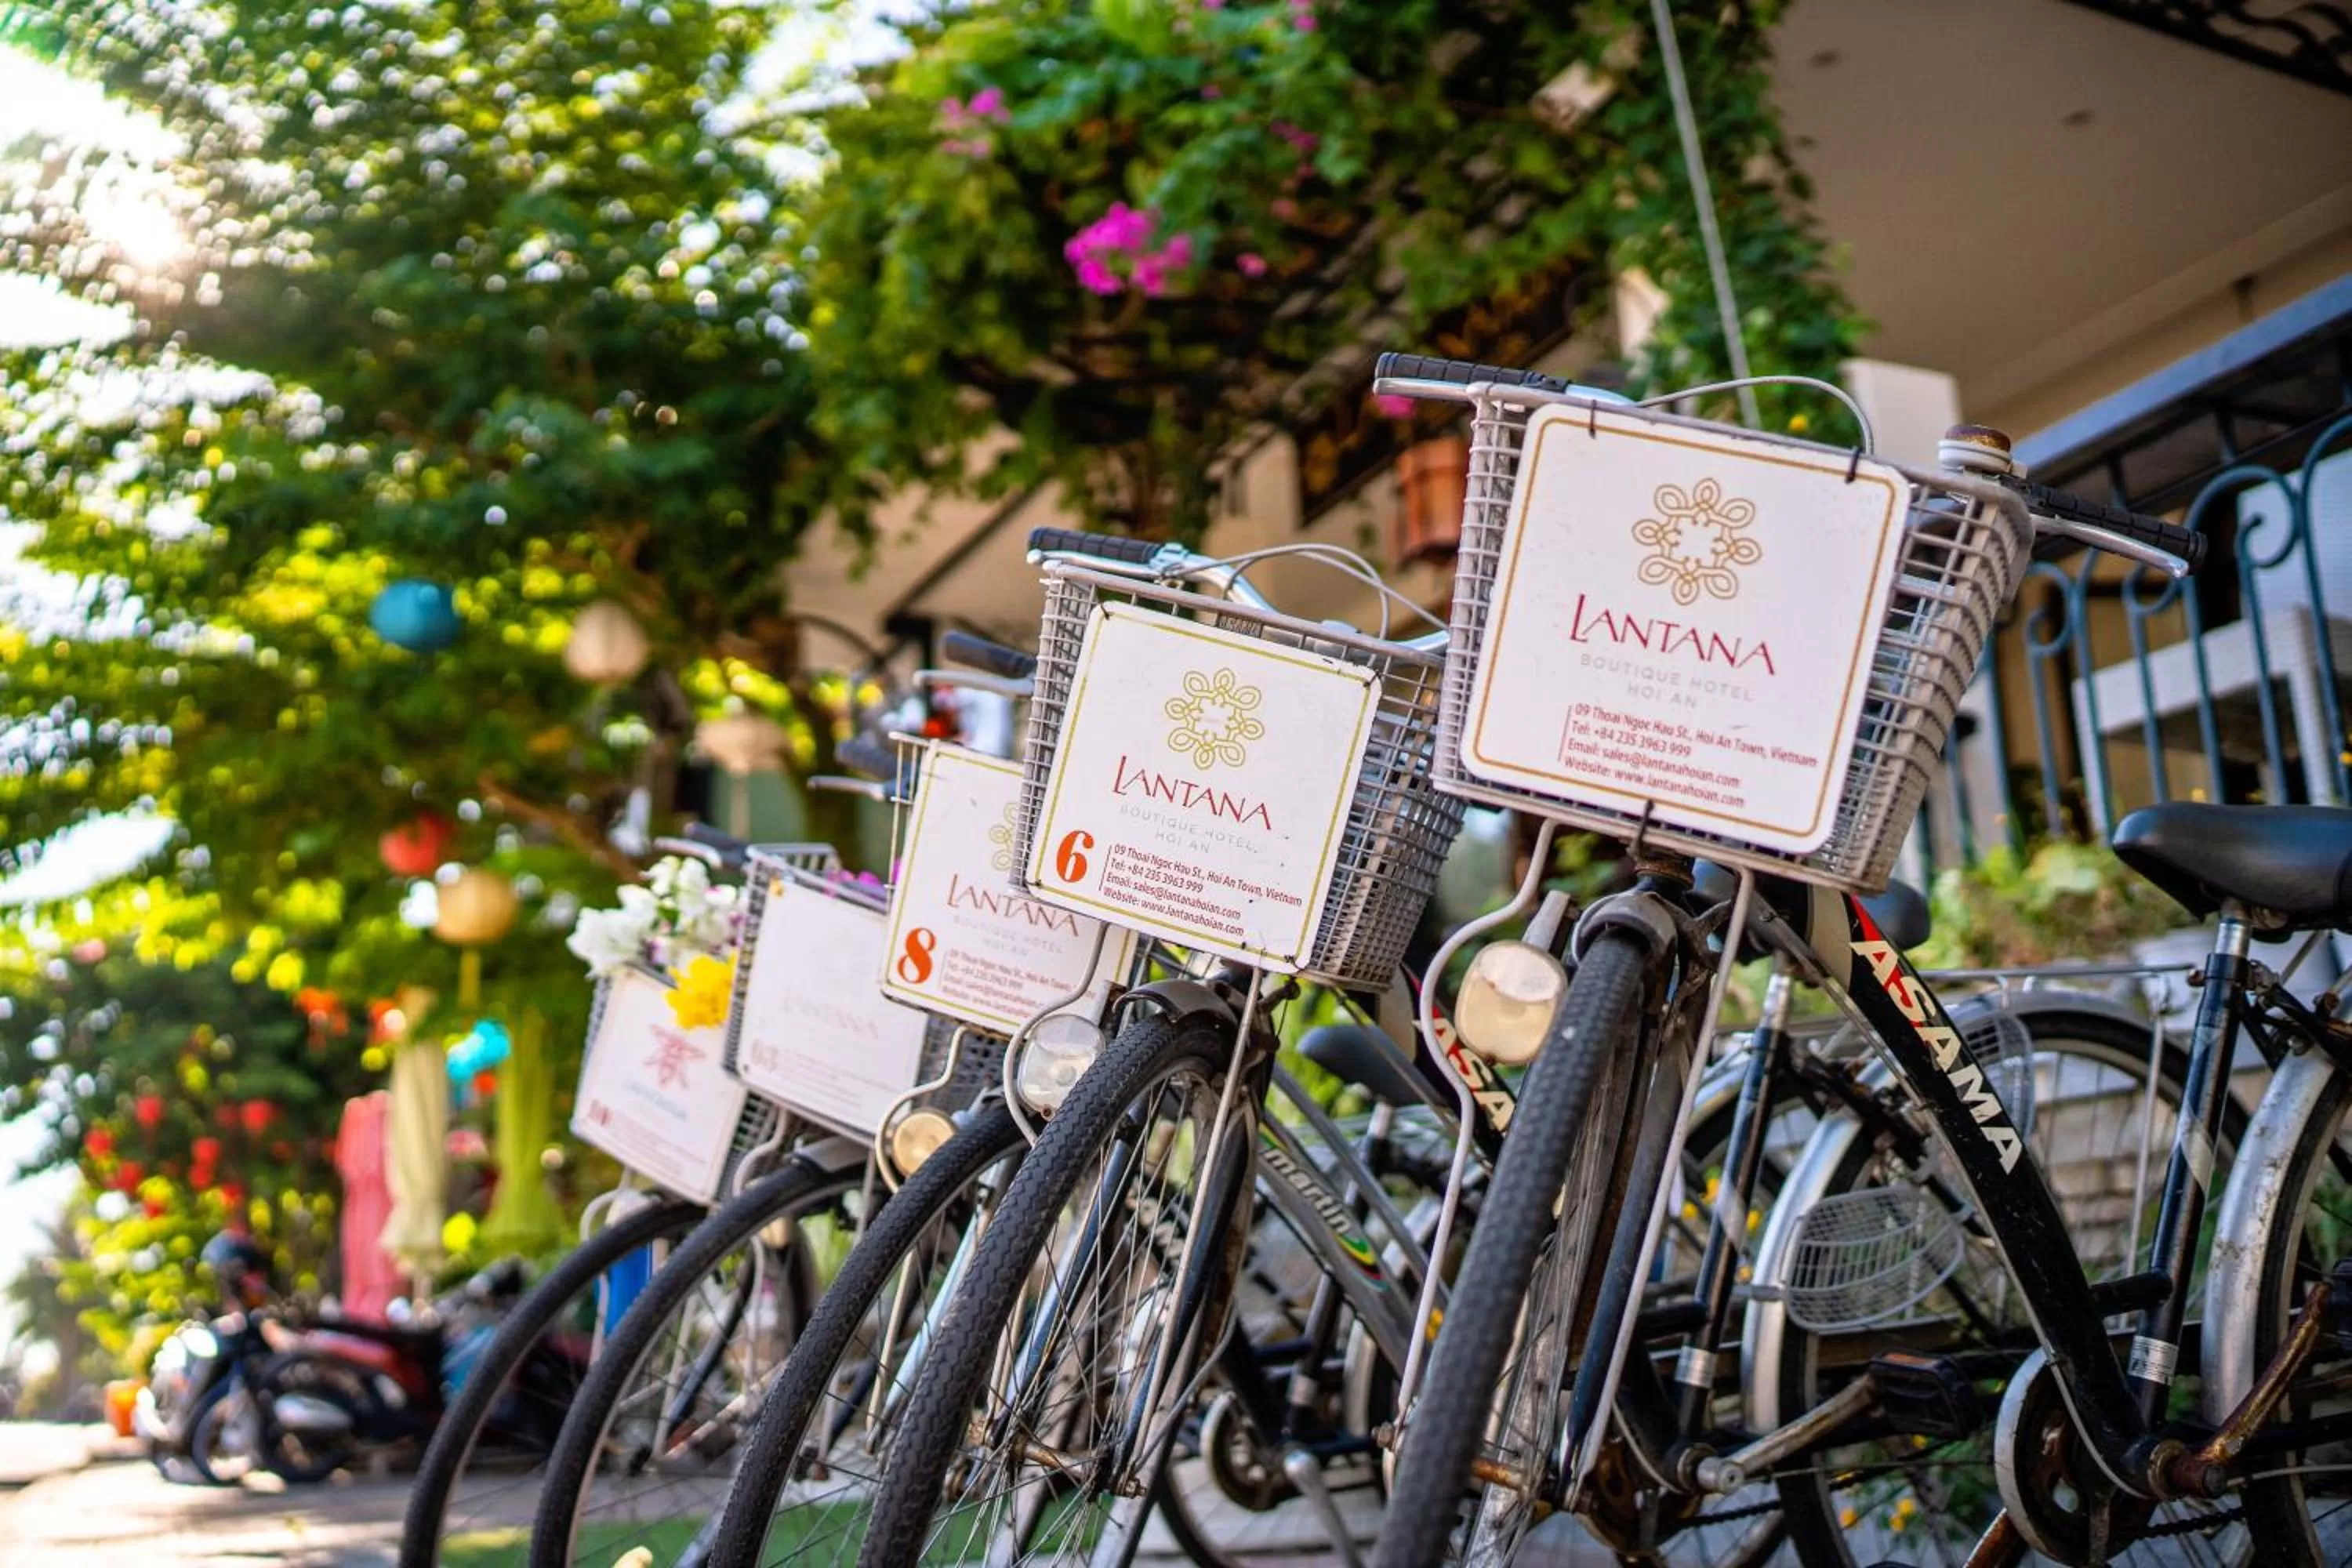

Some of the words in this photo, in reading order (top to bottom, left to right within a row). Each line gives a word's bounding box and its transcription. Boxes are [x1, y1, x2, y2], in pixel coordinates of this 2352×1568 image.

[1570, 593, 1775, 675] LANTANA
[1580, 654, 1682, 686] BOUTIQUE
[1690, 677, 1755, 701] HOTEL
[1627, 683, 1661, 700] HOI
[1670, 693, 1697, 709] AN
[1575, 702, 1590, 716] 09
[1593, 706, 1621, 724] Thoai
[1623, 714, 1650, 731] Ngoc
[1696, 728, 1714, 744] Hoi
[1717, 735, 1731, 749] An
[1770, 746, 1818, 767] Vietnam
[1594, 727, 1614, 740] +84
[1616, 730, 1637, 746] 235
[1639, 735, 1667, 753] 3963
[1669, 742, 1692, 758] 999
[1112, 755, 1272, 831] LANTANA
[1120, 804, 1200, 835] BOUTIQUE
[1055, 829, 1094, 884] 6
[1154, 829, 1182, 844] HOI
[1189, 840, 1210, 854] AN
[1103, 886, 1139, 906] Website:
[1106, 872, 1132, 888] Email:
[1133, 881, 1241, 920] sales@lantanahoian.com
[1114, 844, 1127, 855] 09
[1127, 848, 1150, 863] Thoai
[1150, 855, 1173, 869] Ngoc
[1174, 861, 1191, 875] Hau
[1207, 870, 1222, 884] Hoi
[1223, 876, 1236, 888] An
[1238, 879, 1263, 897] Town,
[1266, 887, 1302, 907] Vietnam
[1128, 863, 1144, 877] +84
[1145, 868, 1162, 882] 235
[1162, 873, 1185, 888] 3963
[1185, 878, 1203, 894] 999
[946, 873, 1079, 937] LANTANA
[896, 927, 937, 985] 8
[1411, 1018, 1516, 1137] ASA
[1849, 940, 2023, 1175] ASAMA
[1264, 1149, 1351, 1233] martin
